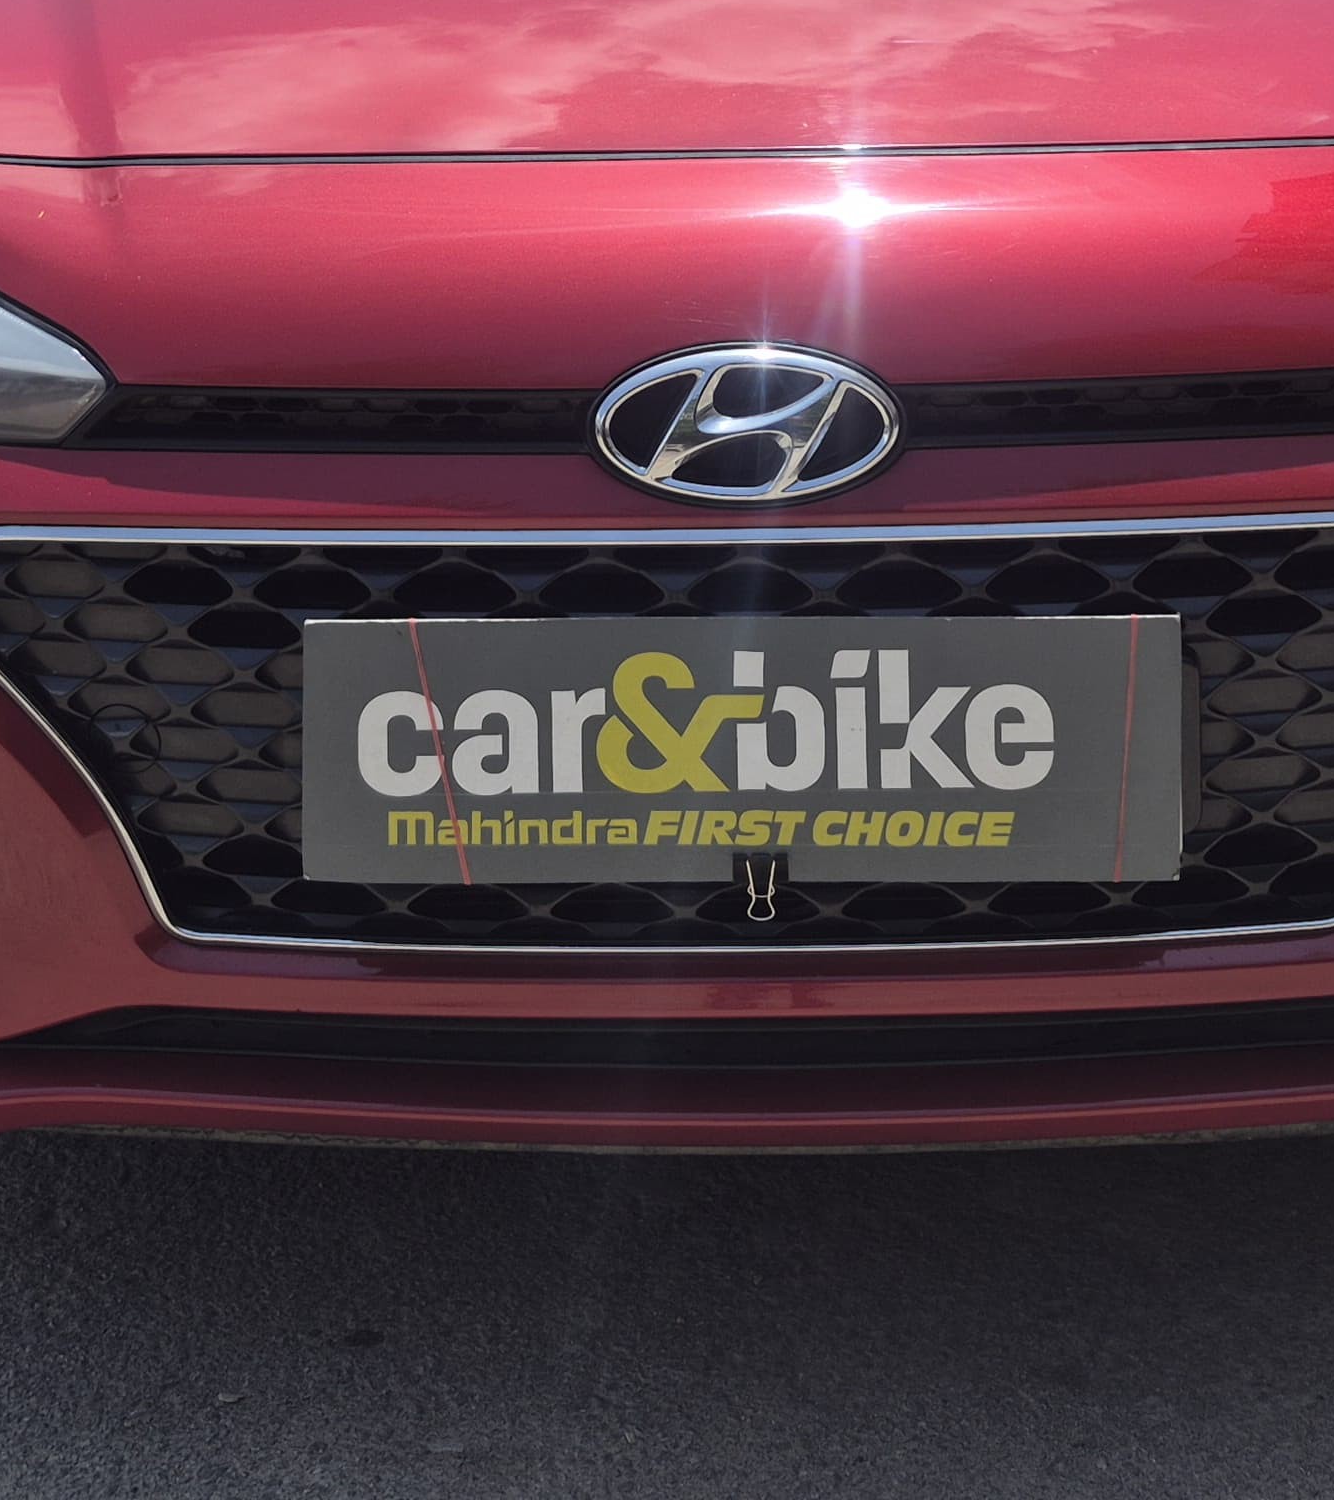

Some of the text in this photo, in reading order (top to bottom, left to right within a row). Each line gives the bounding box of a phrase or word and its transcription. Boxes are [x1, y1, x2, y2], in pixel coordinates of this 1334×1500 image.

[357, 649, 1055, 797] car&bike
[388, 811, 1014, 848] Mahindra FIRST CHOICE
